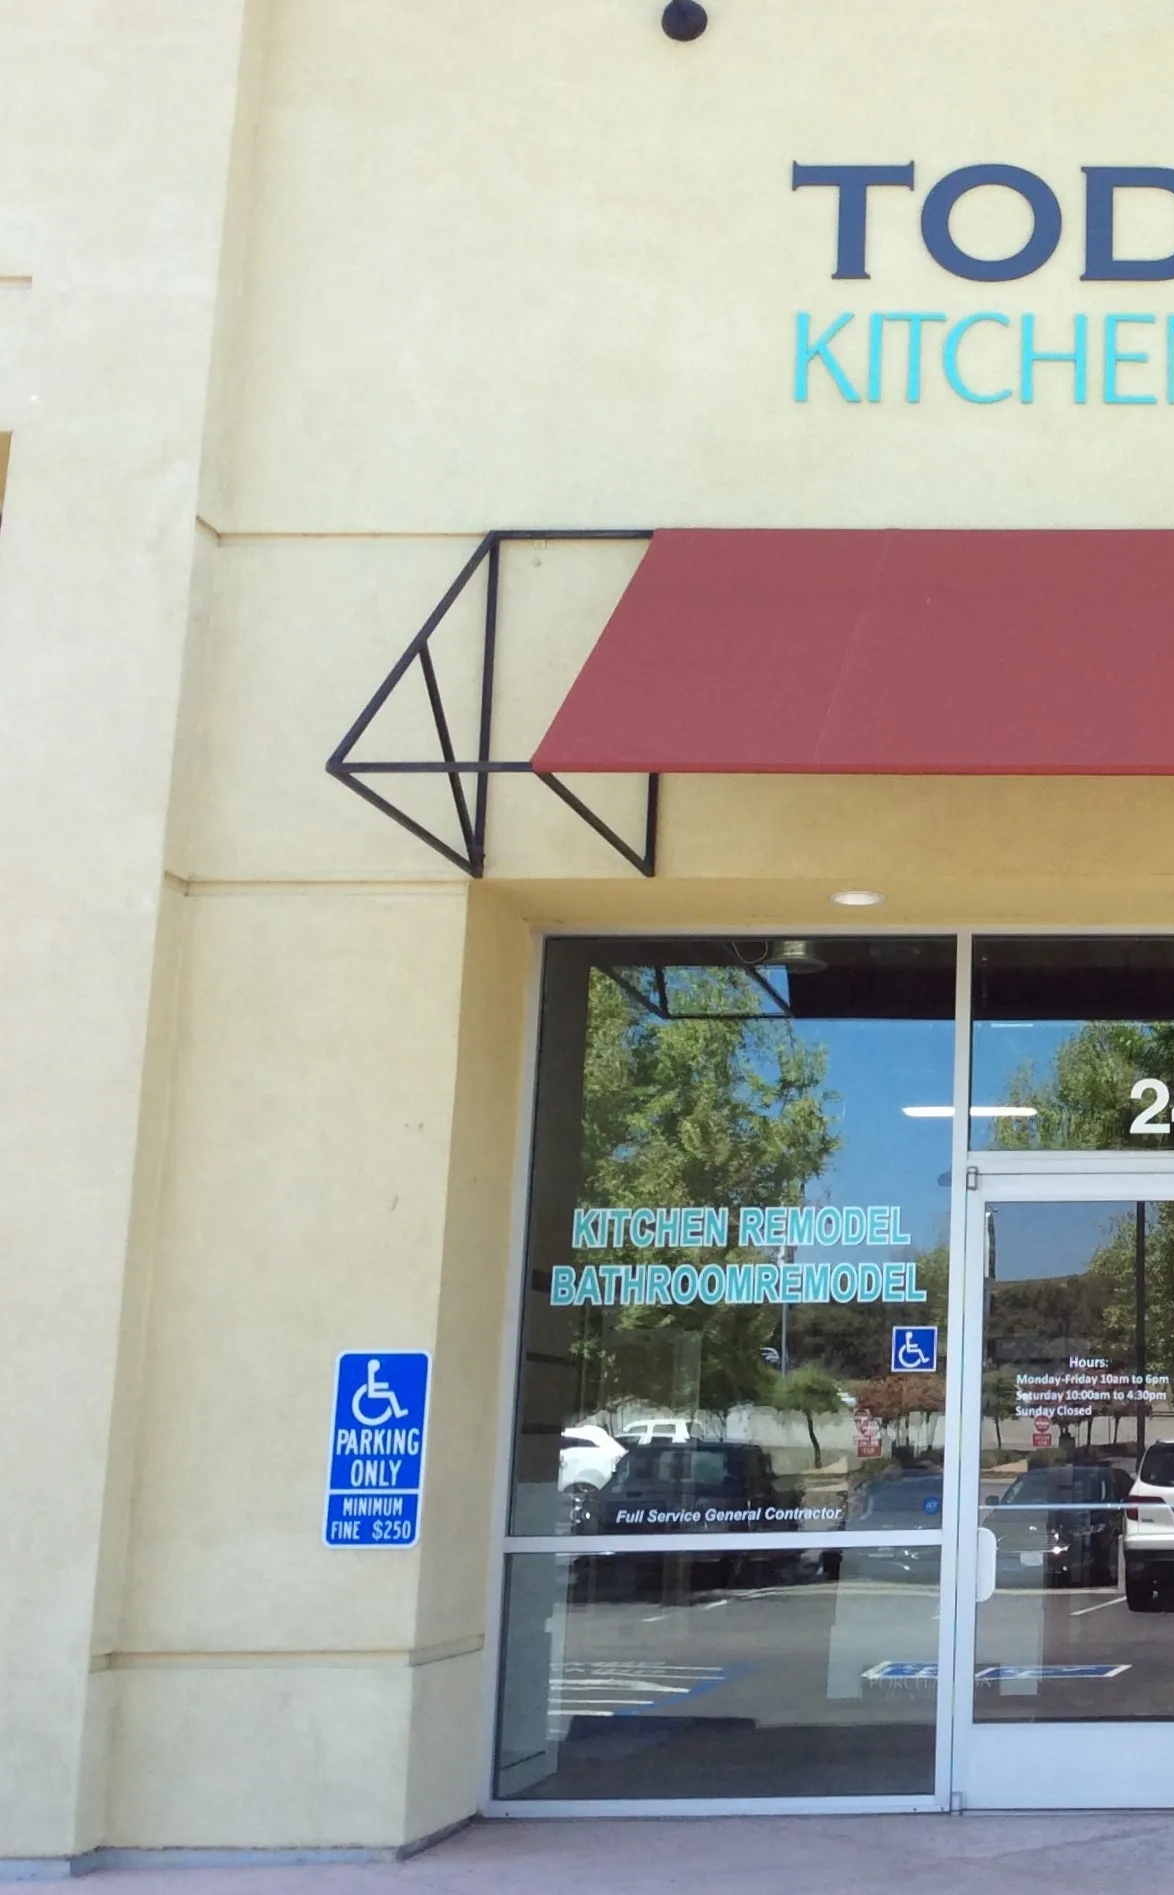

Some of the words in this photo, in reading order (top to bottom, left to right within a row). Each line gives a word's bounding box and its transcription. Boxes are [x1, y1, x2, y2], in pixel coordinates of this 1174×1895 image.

[571, 1207, 728, 1249] KITCHEN
[739, 1205, 911, 1246] REMODEL
[1069, 1356, 1109, 1368] Hours:
[1016, 1374, 1098, 1386] Monday-Friday
[1100, 1374, 1129, 1384] 10am
[1132, 1374, 1144, 1384] to
[1145, 1374, 1170, 1386] 6pm
[1066, 1391, 1111, 1400] 10:00am
[1113, 1391, 1125, 1400] to
[1015, 1406, 1054, 1418] Sunday
[1057, 1406, 1092, 1416] Closed
[335, 1427, 421, 1456] PARKING
[350, 1459, 403, 1487] ONLY
[342, 1498, 404, 1517] MINIMUM
[616, 1509, 643, 1524] Full
[647, 1508, 701, 1523] Service
[705, 1507, 760, 1522] General
[764, 1506, 842, 1520] Contractor
[330, 1520, 362, 1540] FINE
[371, 1519, 412, 1541] $250
